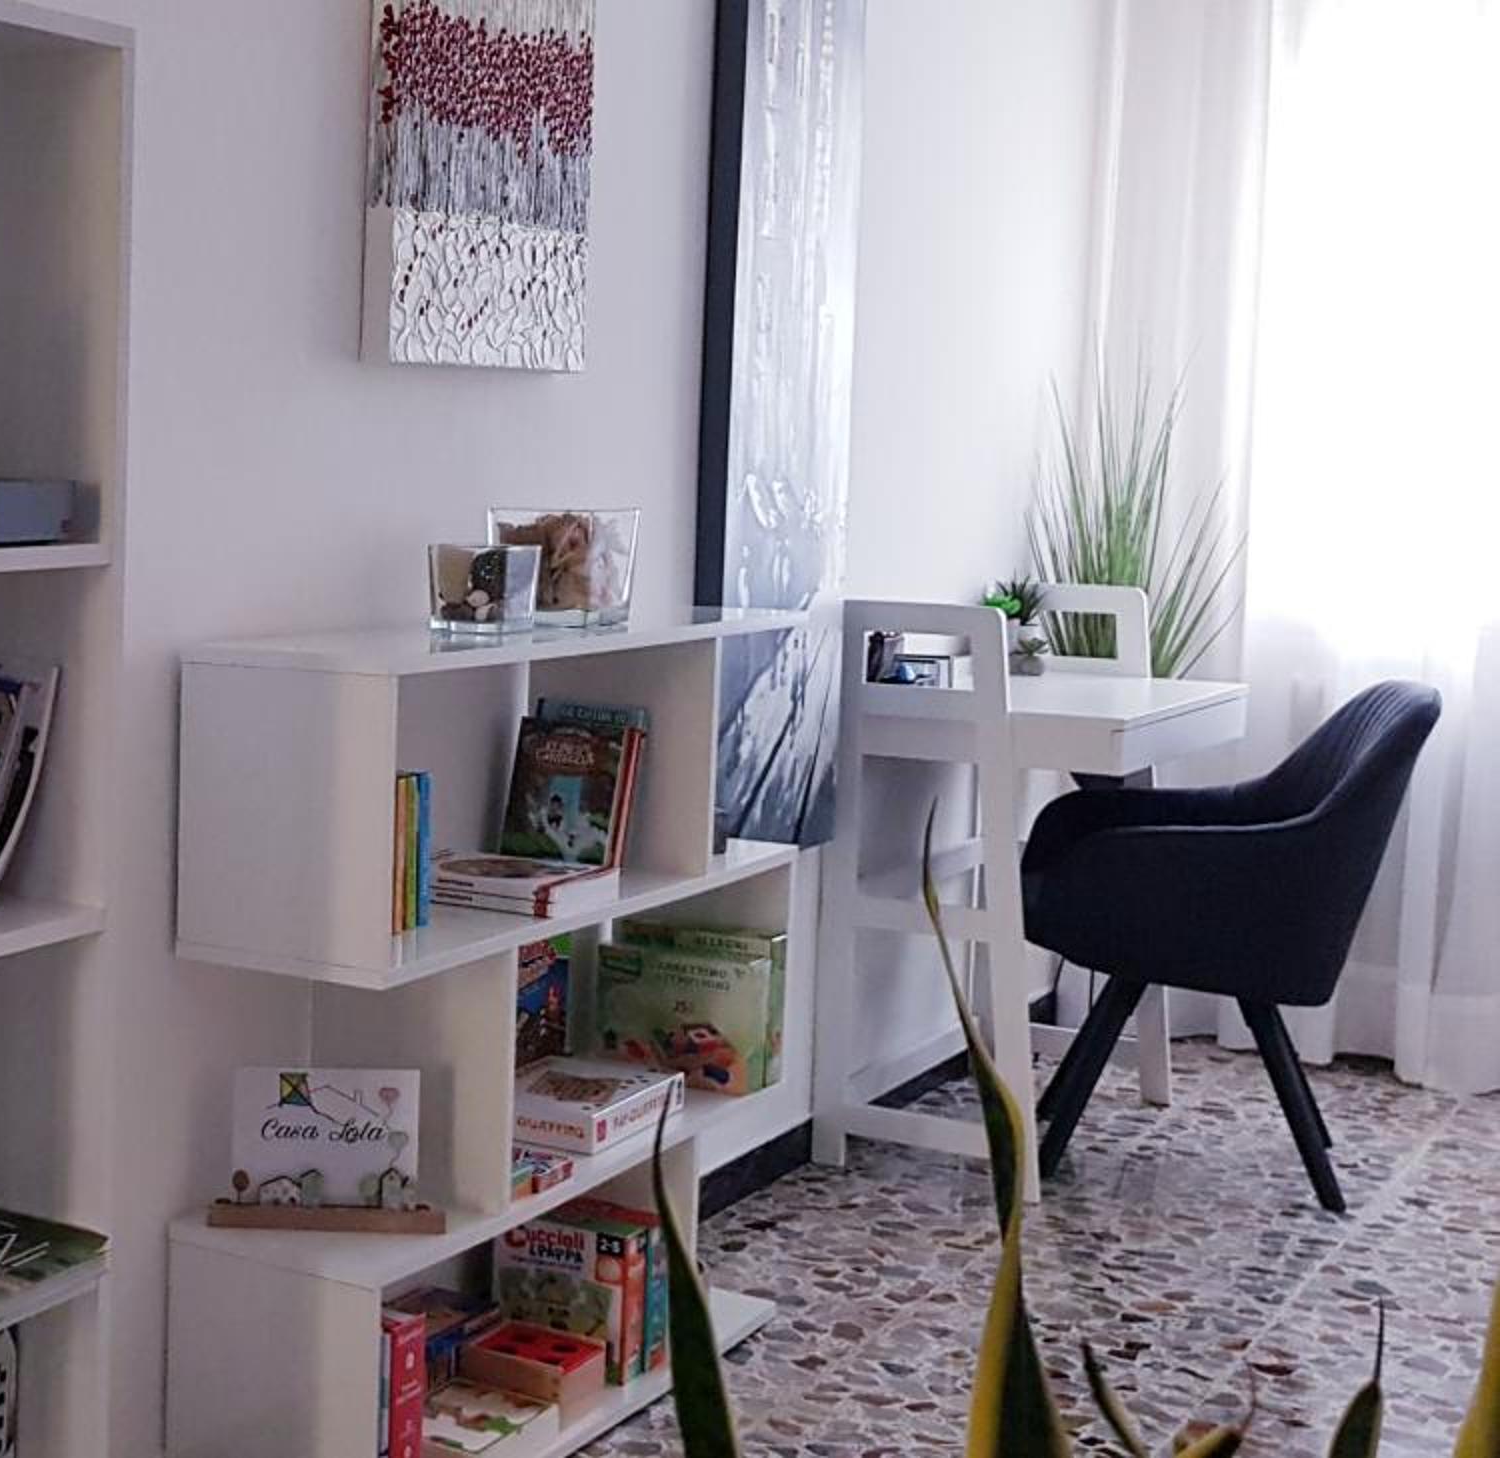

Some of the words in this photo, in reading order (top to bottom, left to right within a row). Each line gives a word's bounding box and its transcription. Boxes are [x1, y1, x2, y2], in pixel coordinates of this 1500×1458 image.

[260, 1117, 320, 1142] Casa
[328, 1118, 387, 1145] Lola
[505, 1224, 585, 1250] Cuccioli
